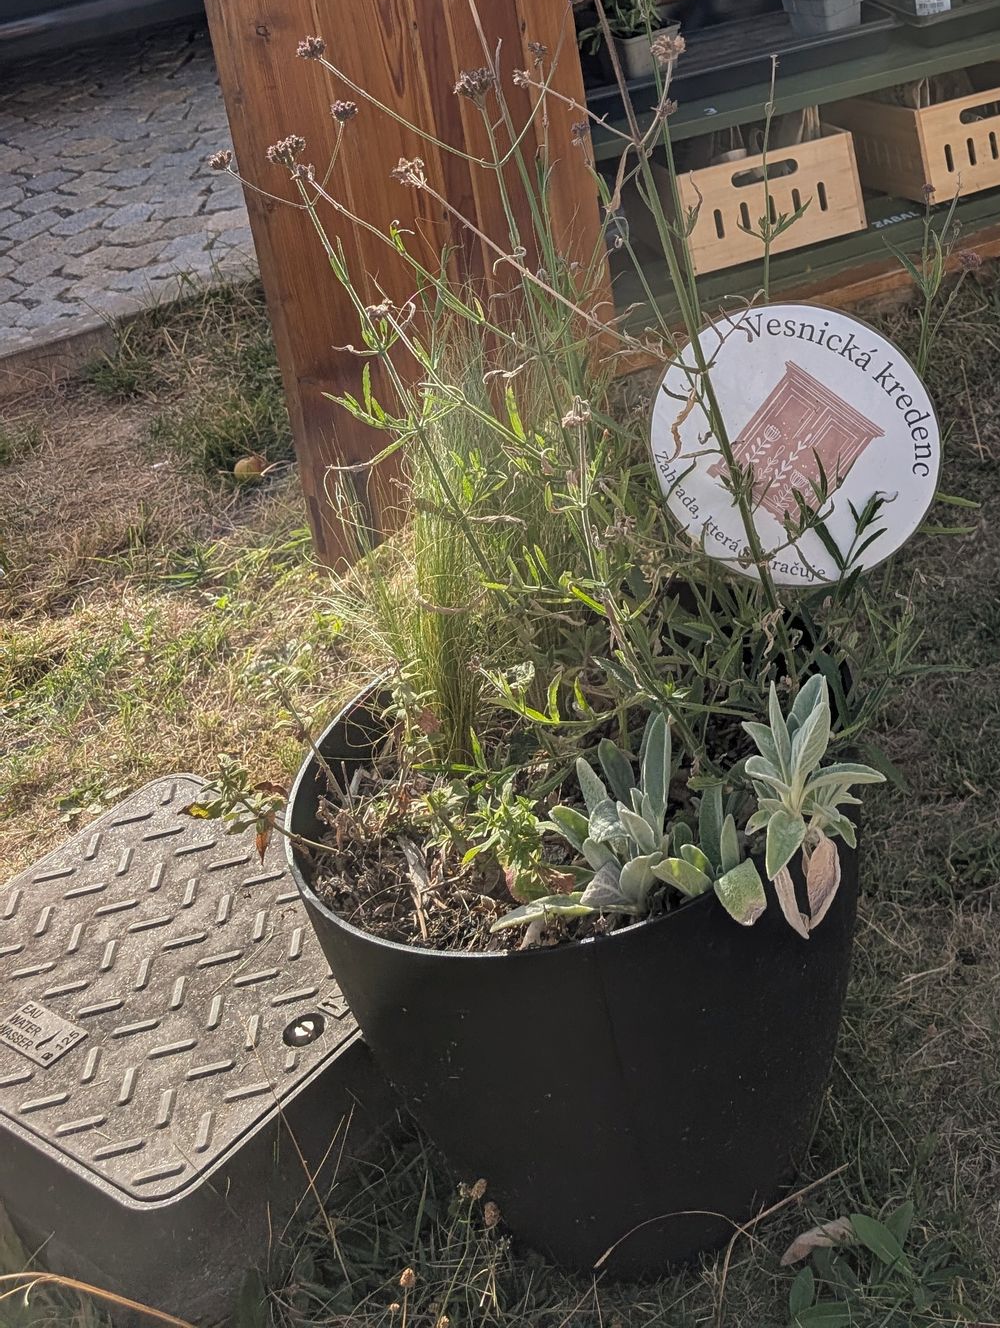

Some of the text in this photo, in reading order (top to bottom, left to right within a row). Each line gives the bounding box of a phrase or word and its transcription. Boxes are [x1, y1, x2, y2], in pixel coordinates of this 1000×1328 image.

[744, 313, 935, 479] Vesnická kredenc
[701, 514, 742, 553] která
[21, 1004, 44, 1019] EAU
[9, 1013, 42, 1038] WATER
[54, 1030, 80, 1051] 125
